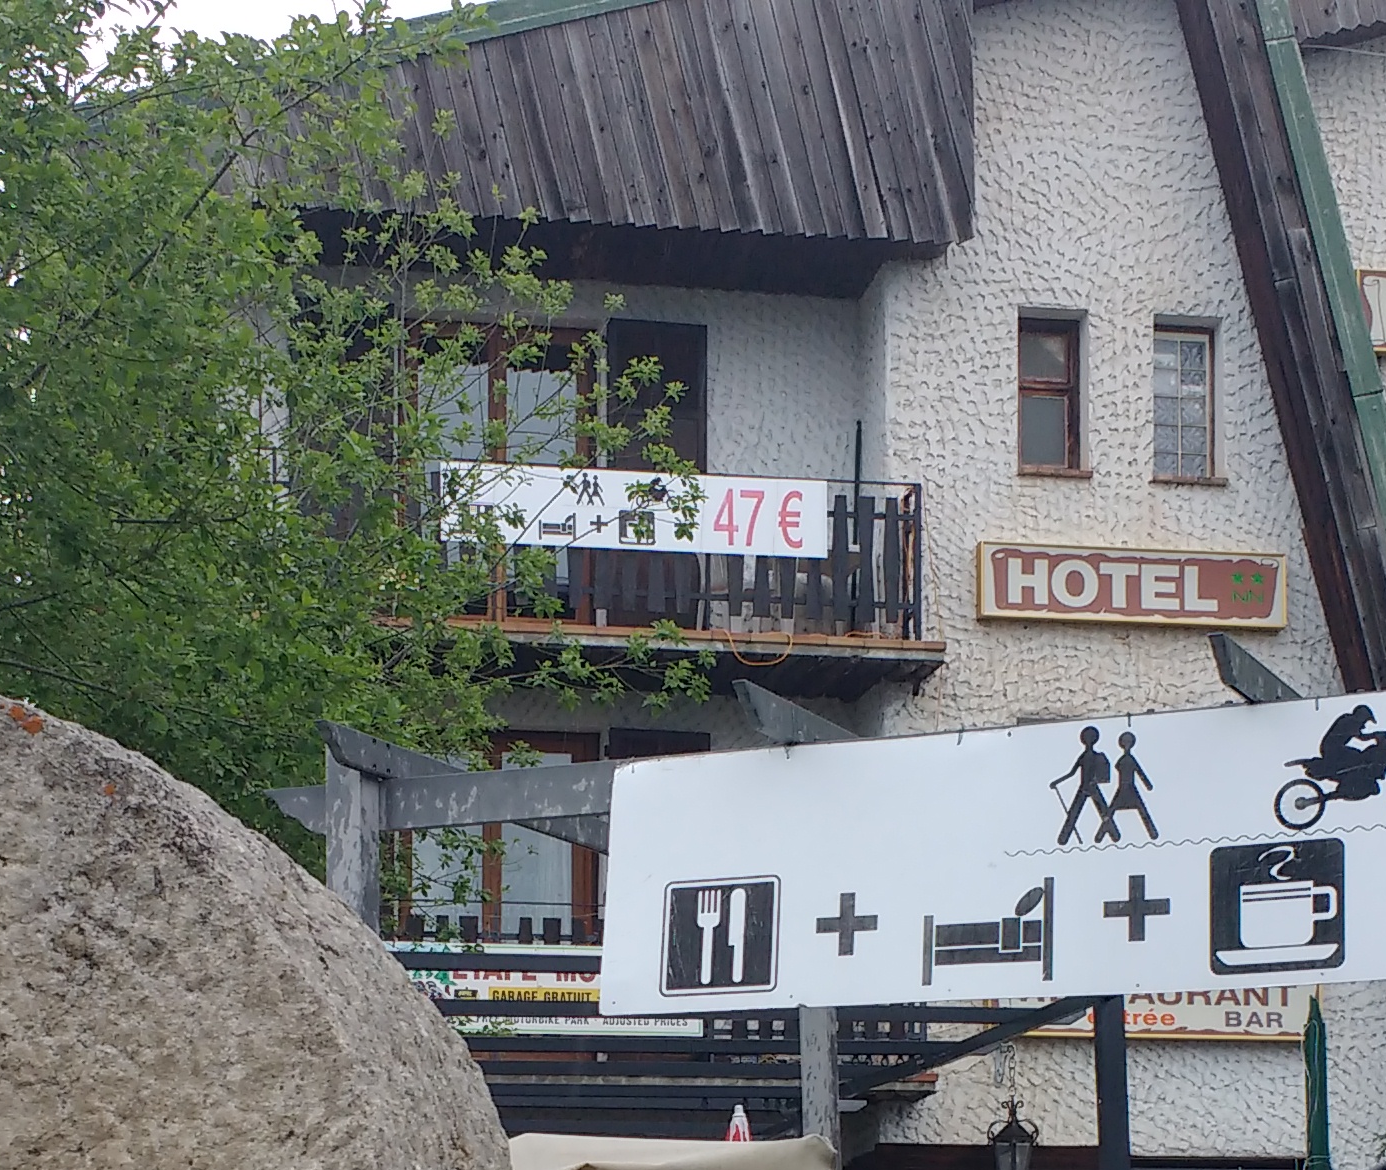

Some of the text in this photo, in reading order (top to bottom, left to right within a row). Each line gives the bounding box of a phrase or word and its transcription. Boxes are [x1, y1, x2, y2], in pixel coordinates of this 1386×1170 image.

[714, 488, 803, 549] 47 €
[1007, 557, 1219, 613] HOTEL
[493, 989, 538, 1002] GARAGE
[1224, 1011, 1284, 1028] BAR
